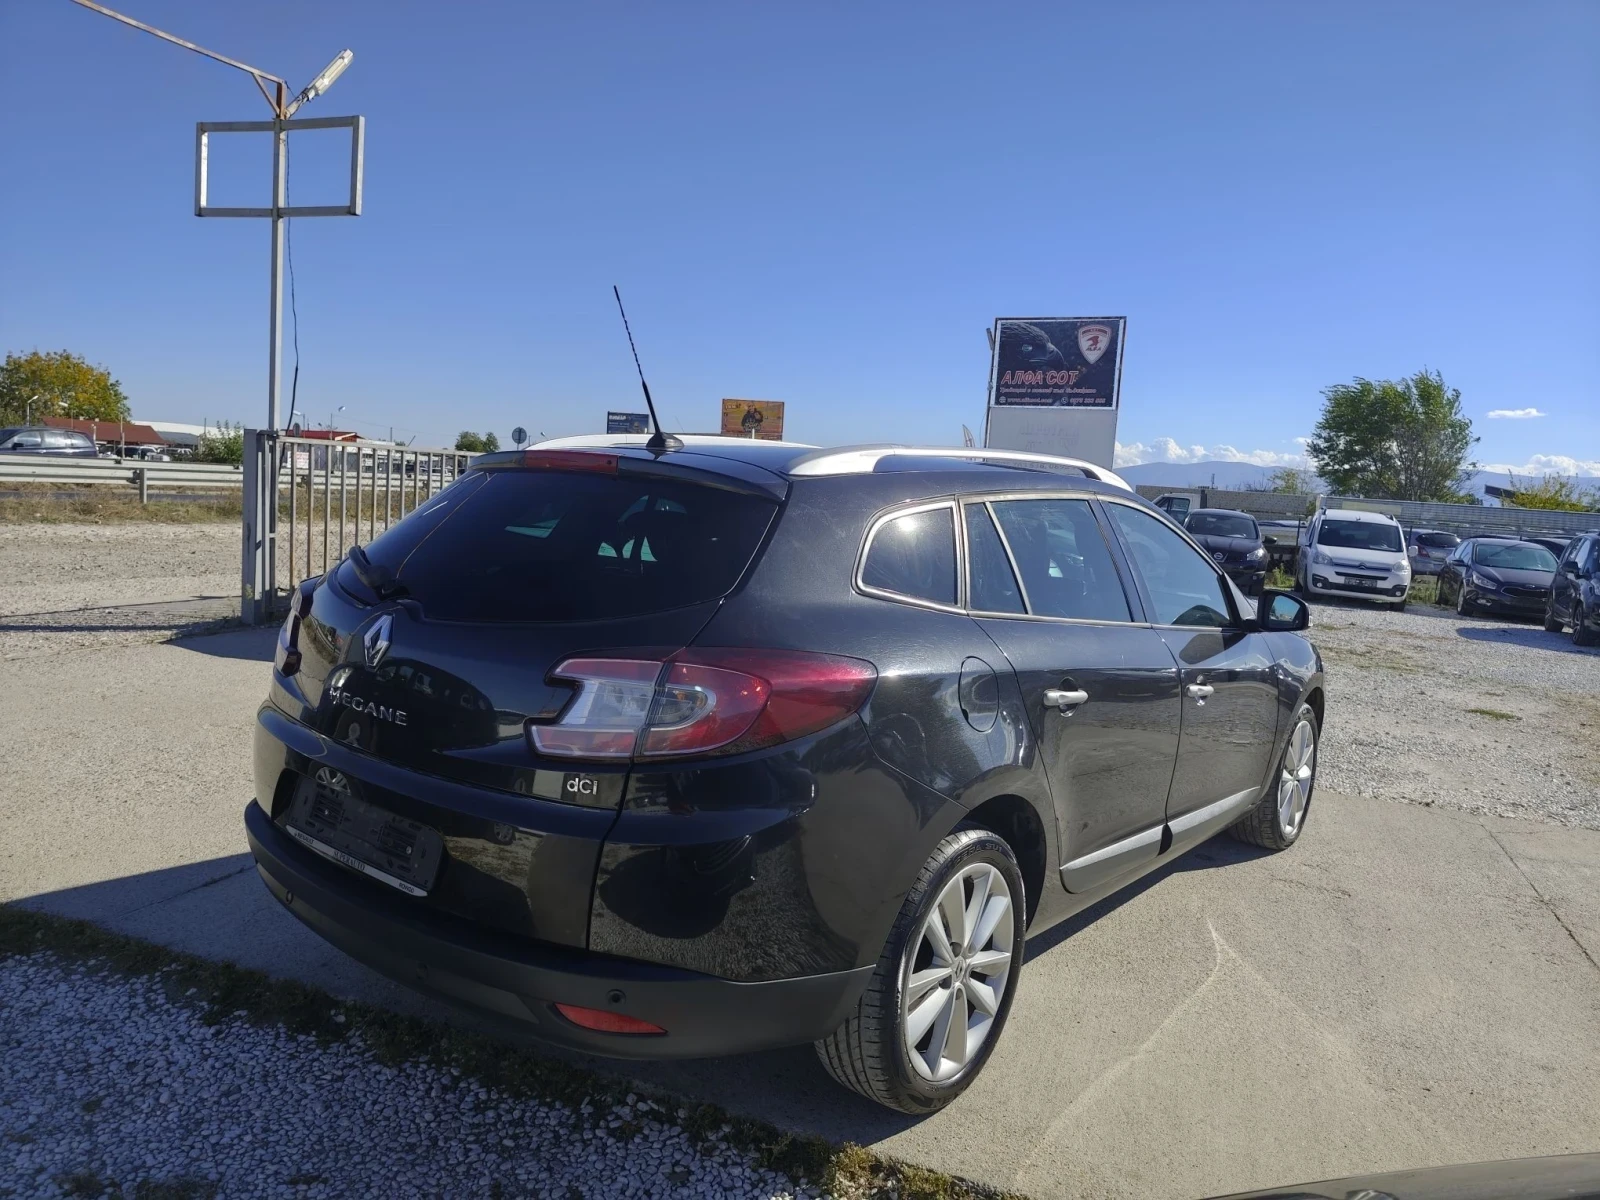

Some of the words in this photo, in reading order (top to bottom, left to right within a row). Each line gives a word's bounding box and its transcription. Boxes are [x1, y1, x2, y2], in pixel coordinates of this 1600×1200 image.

[1001, 371, 1043, 384] АЛФА
[1046, 371, 1079, 385] СОТ
[329, 687, 407, 726] MEGANE
